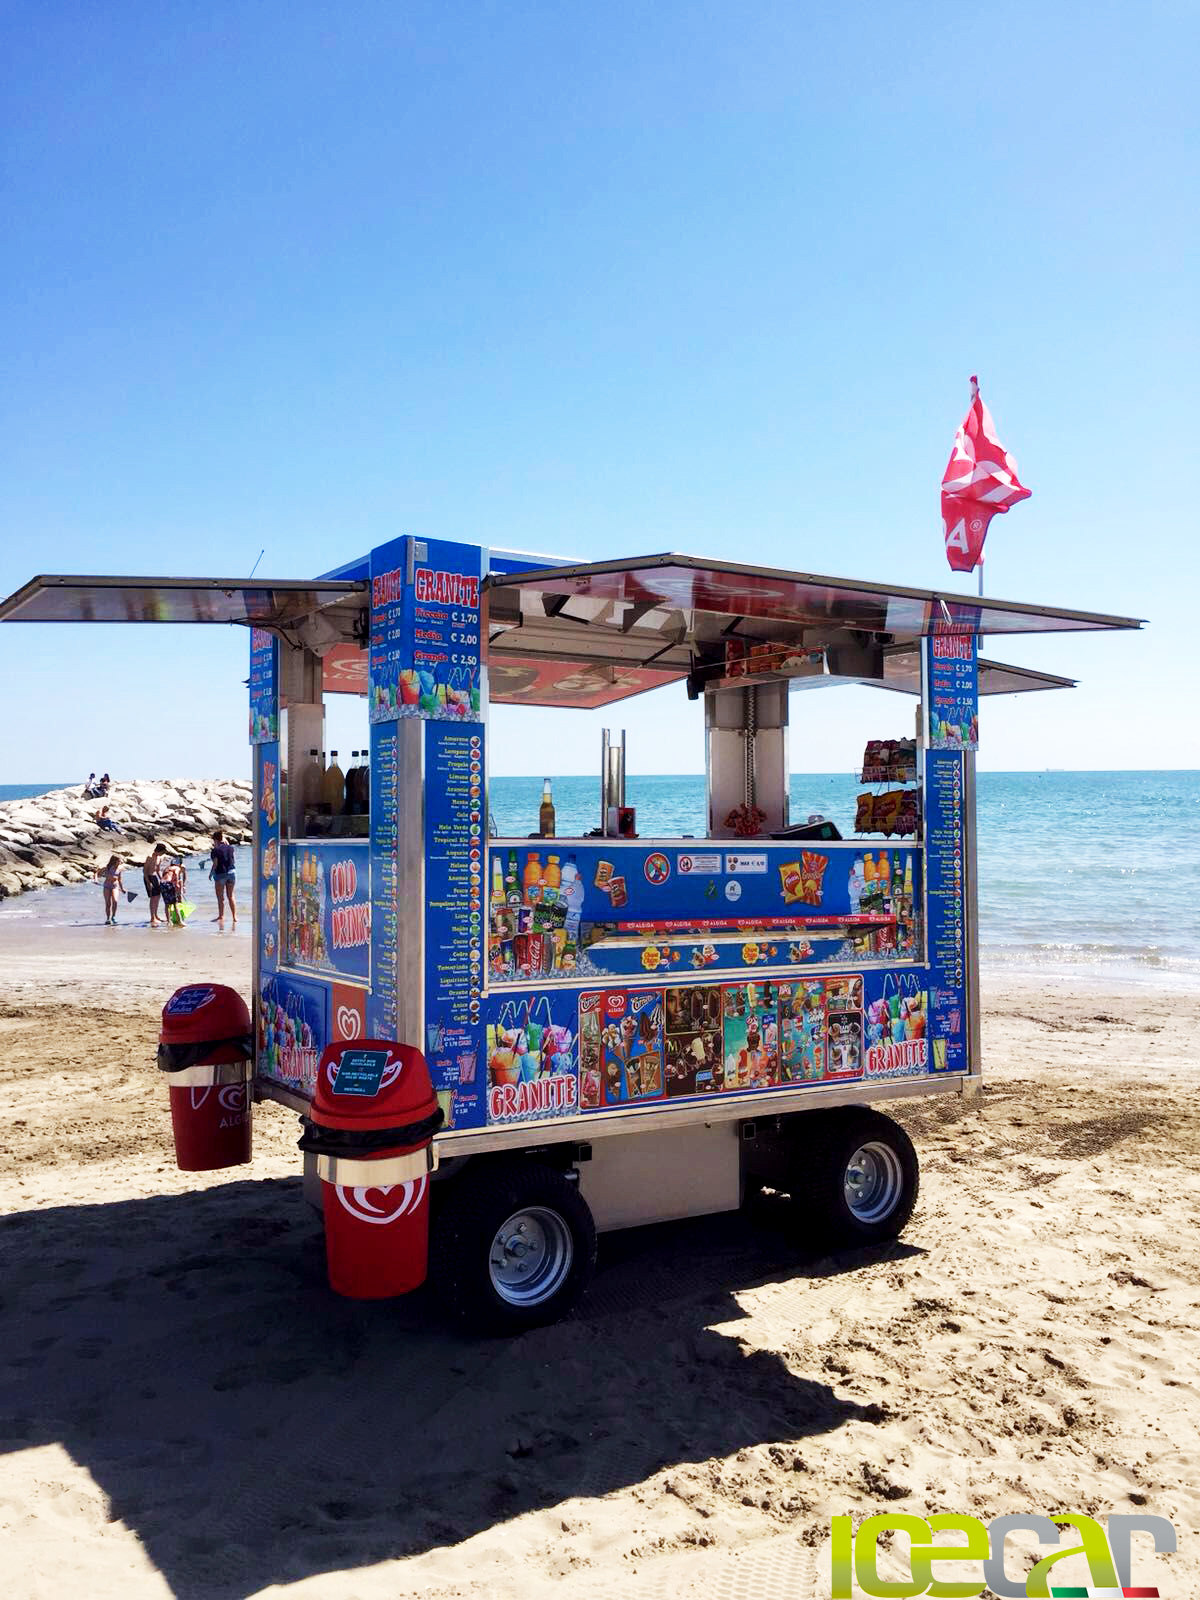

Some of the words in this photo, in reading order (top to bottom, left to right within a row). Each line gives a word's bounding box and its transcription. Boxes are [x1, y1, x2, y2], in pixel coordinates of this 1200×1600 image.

[415, 568, 479, 609] GRANITE
[460, 613, 478, 624] 1,70
[460, 634, 477, 646] 2,00
[460, 655, 477, 666] 2,50
[331, 859, 357, 904] COLD
[332, 902, 370, 950] DRINK
[866, 1038, 928, 1076] GRANITE
[490, 1074, 577, 1120] GRANITE
